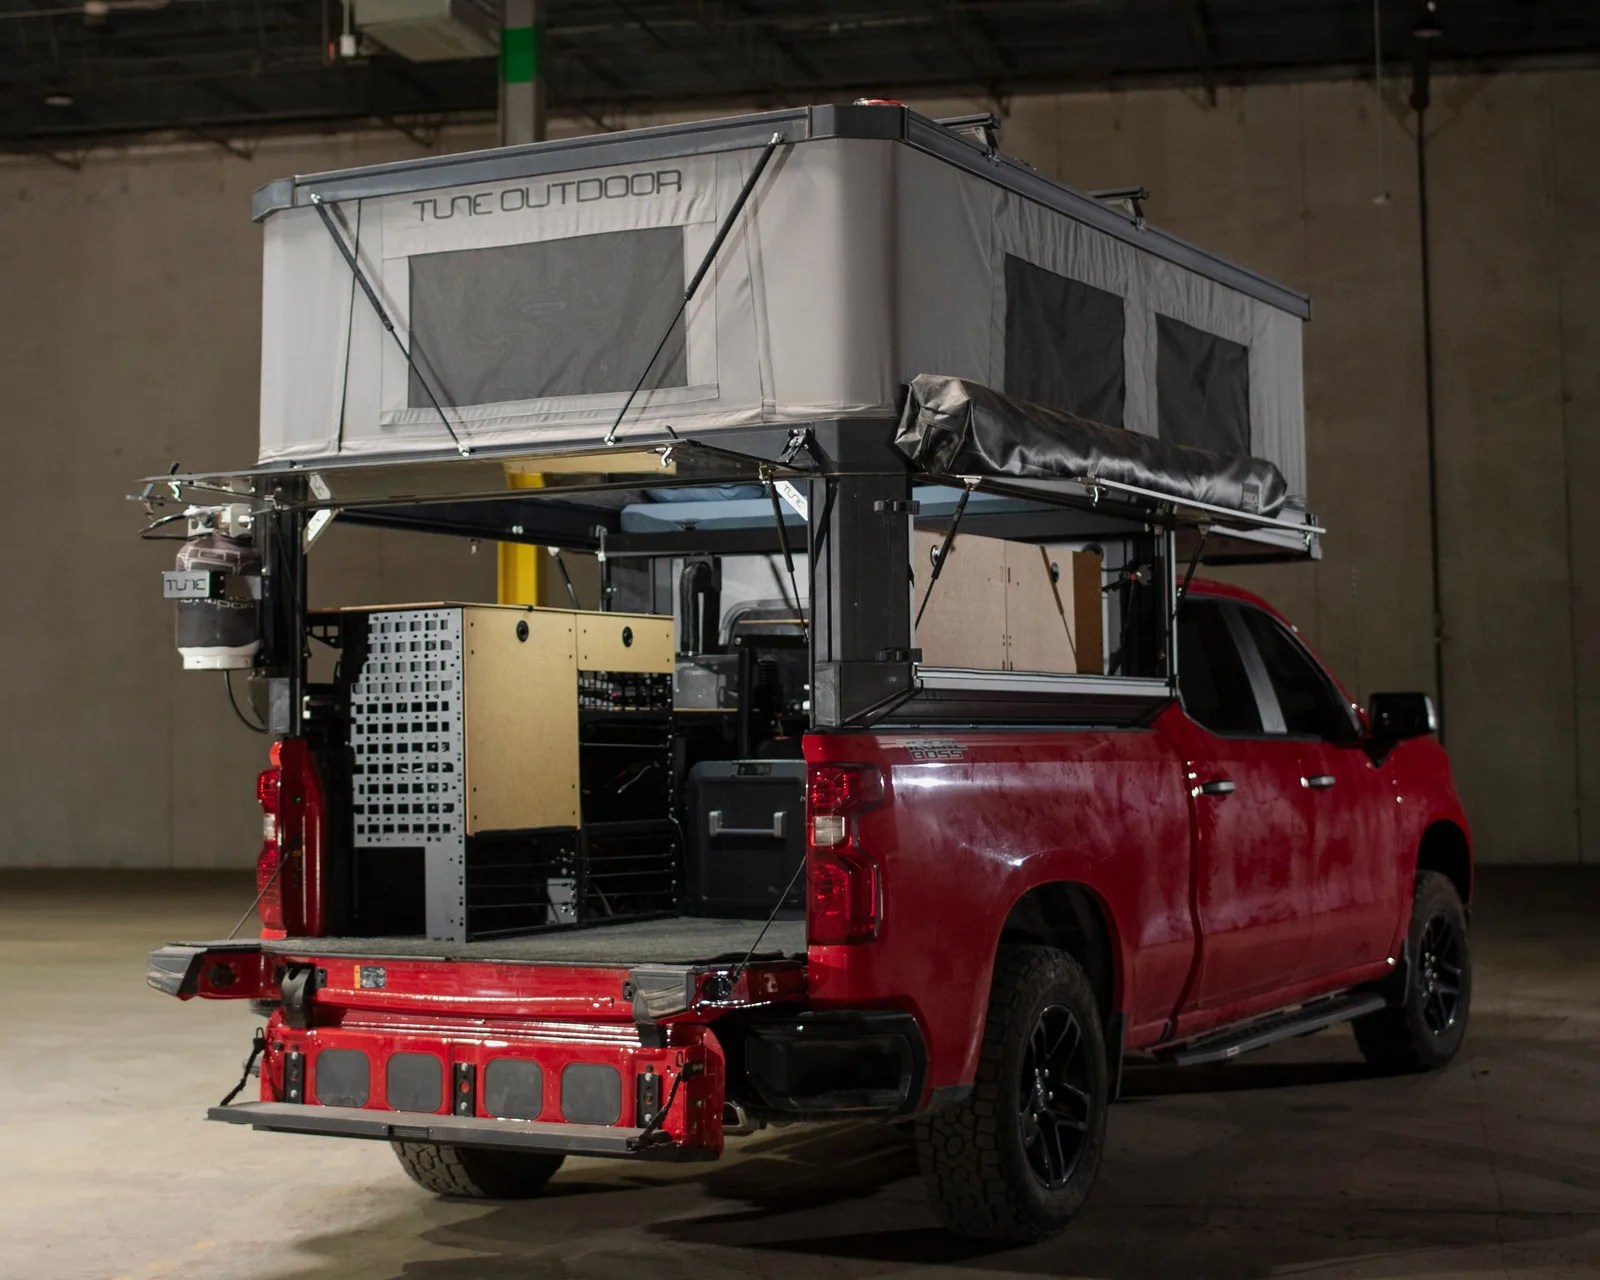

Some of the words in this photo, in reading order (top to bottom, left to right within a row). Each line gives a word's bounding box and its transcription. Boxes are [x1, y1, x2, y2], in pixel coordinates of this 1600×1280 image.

[412, 192, 493, 222] TUNE
[500, 169, 682, 212] OUTDOOR
[783, 484, 805, 508] TUNE
[165, 579, 206, 591] TUNE
[910, 749, 964, 761] BOSS
